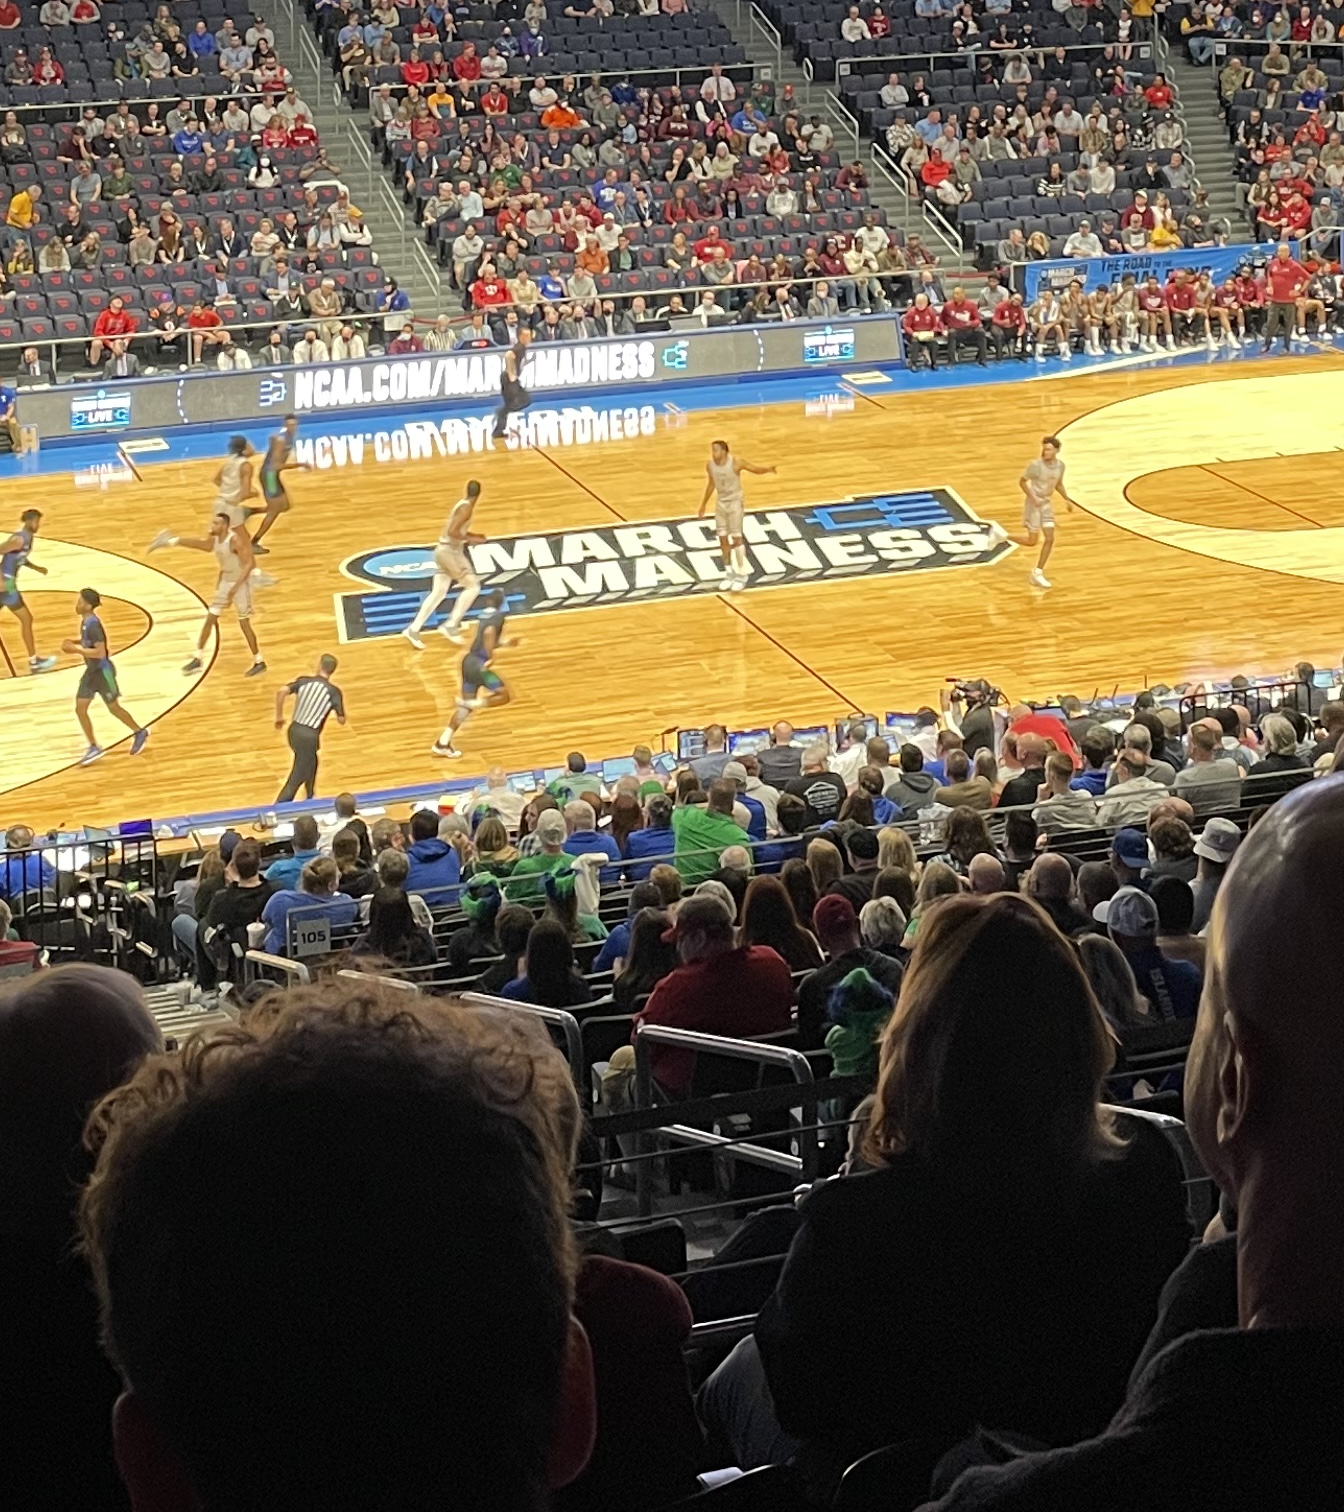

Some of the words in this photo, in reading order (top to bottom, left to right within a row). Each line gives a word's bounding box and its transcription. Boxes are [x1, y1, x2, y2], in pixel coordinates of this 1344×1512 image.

[1101, 260, 1120, 273] THE
[1122, 257, 1152, 271] ROAD
[88, 409, 113, 422] LIVE
[468, 511, 814, 575] MARCH
[538, 521, 995, 600] MADNESS
[301, 930, 326, 944] 105
